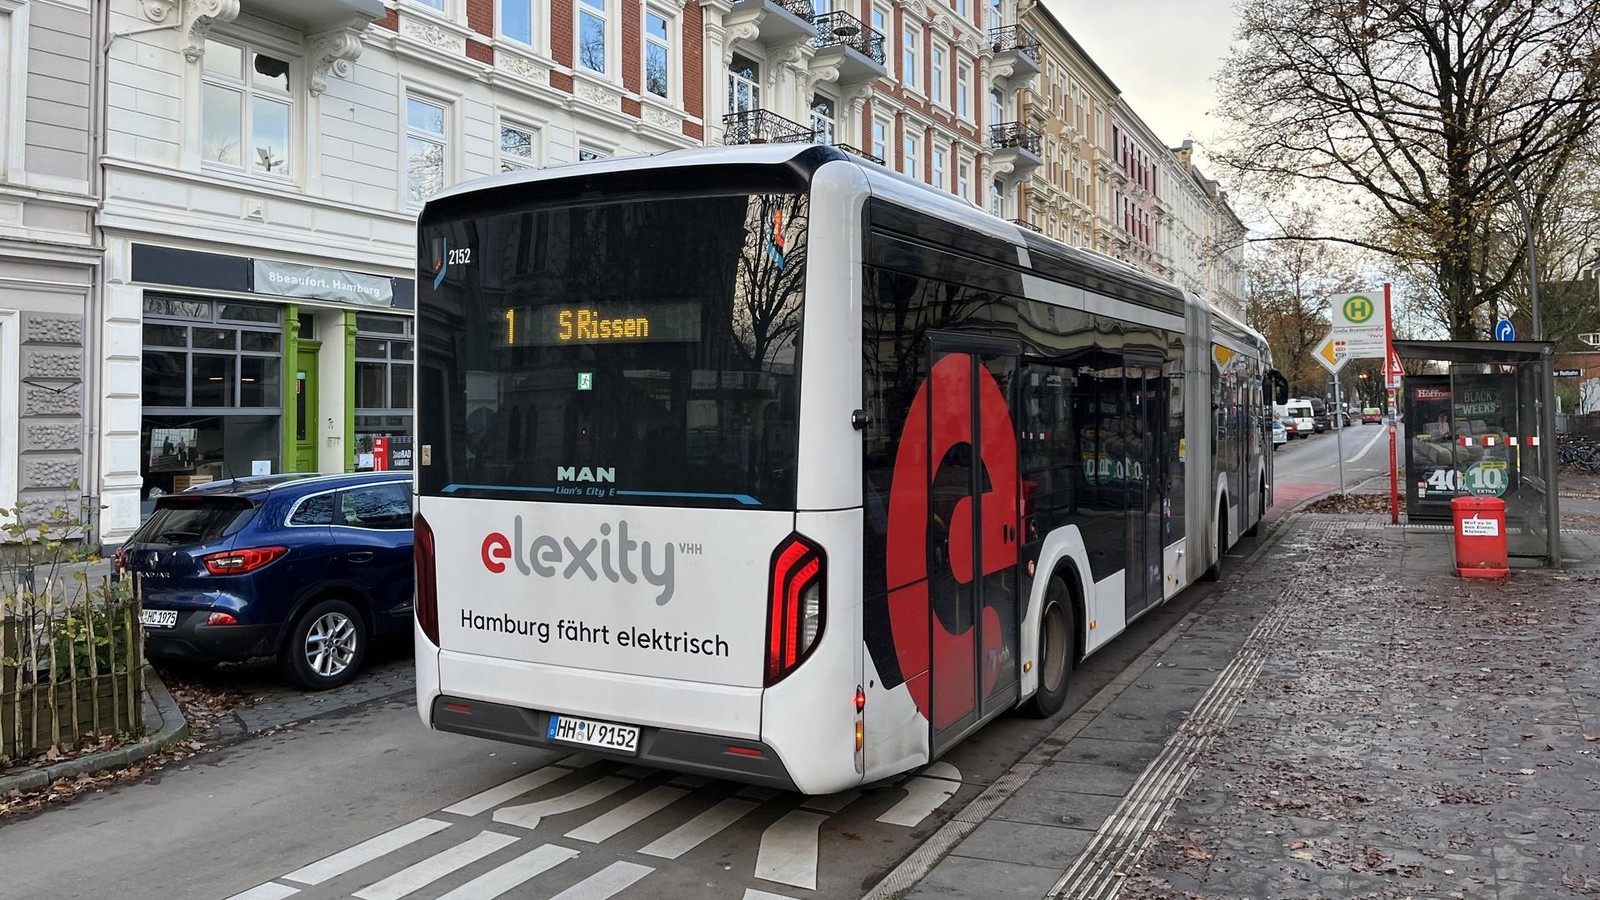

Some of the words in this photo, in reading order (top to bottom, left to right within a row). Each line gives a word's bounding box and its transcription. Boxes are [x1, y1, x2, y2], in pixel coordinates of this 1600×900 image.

[448, 248, 472, 266] 2152
[268, 271, 330, 289] 8beaufort.
[332, 279, 382, 298] Hamburg
[1350, 302, 1366, 317] H
[505, 308, 515, 345] 1
[558, 310, 574, 340] S
[576, 308, 650, 340] Rissen
[1464, 391, 1492, 403] BLACK
[1463, 403, 1497, 415] WEEKS
[556, 465, 617, 483] MAN
[555, 485, 583, 496] Lion's
[585, 486, 607, 498] City
[609, 488, 616, 497] E
[679, 542, 704, 556] VHH
[481, 514, 676, 607] elexity
[157, 611, 177, 624] 1975
[460, 609, 551, 644] Hamburg
[557, 619, 610, 646] fährt
[616, 626, 731, 658] elektrisch
[556, 716, 577, 741] HH
[586, 722, 598, 743] V
[598, 725, 637, 749] 9152
